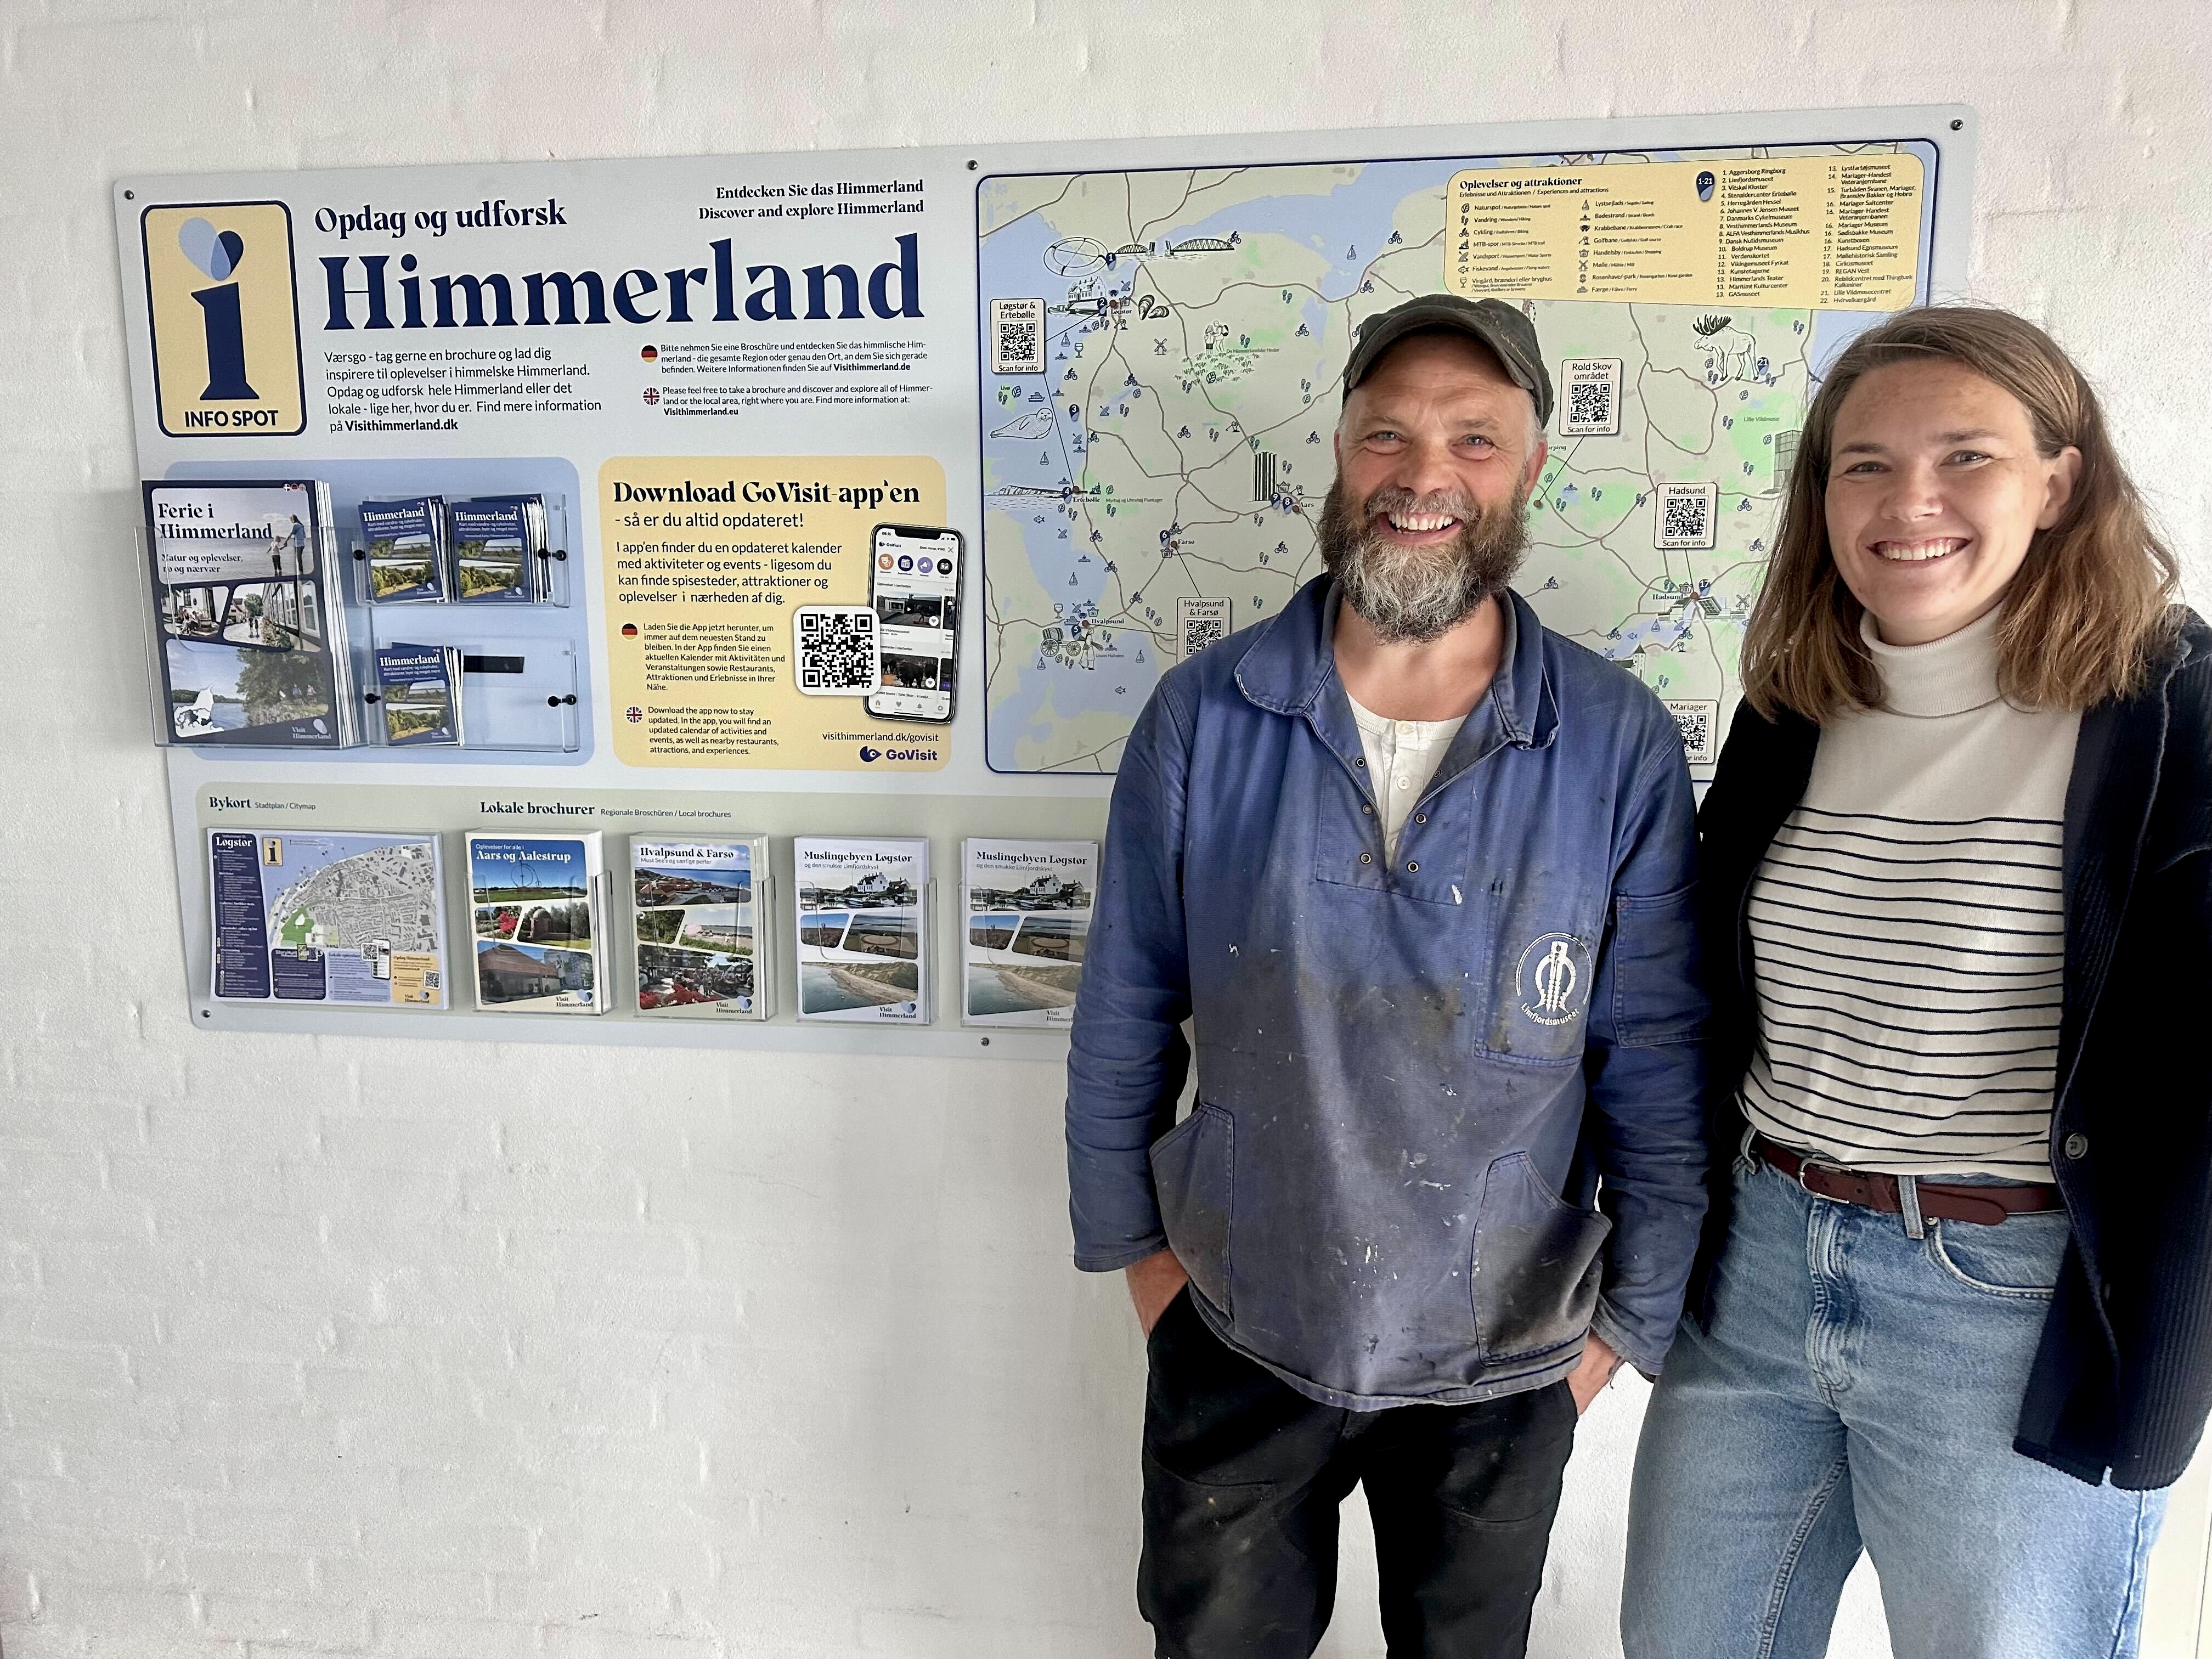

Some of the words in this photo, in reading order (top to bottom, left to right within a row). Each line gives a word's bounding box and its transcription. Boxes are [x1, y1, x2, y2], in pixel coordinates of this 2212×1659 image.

[716, 184, 785, 199] Entdecken
[788, 184, 808, 196] Sie
[811, 183, 834, 196] das
[837, 179, 924, 195] Himmerland
[1460, 179, 1509, 191] Oplevelser
[1510, 180, 1522, 190] og
[1524, 177, 1583, 187] attraktioner
[699, 207, 755, 219] Discover
[758, 204, 783, 217] and
[786, 203, 834, 219] explore
[837, 199, 924, 215] Himmerland
[315, 204, 407, 240] Opdag
[414, 211, 447, 236] og
[455, 198, 567, 228] udforsk
[319, 233, 925, 330] Himmerland
[1000, 302, 1028, 311] Løgstør
[1000, 311, 1035, 319] Ertebølle
[326, 369, 375, 382] inspirere
[376, 368, 387, 379] til
[390, 367, 447, 381] oplevelser
[449, 366, 452, 378] i
[455, 365, 515, 377] himmelske
[517, 364, 590, 376] Himmerland.
[662, 365, 695, 374] befinden.
[696, 365, 727, 373] Weitere
[729, 364, 781, 373] Informationen
[782, 364, 806, 372] finden
[820, 363, 832, 371] auf
[833, 362, 911, 371] Visithimmerland.de
[1572, 363, 1590, 371] Rold
[1592, 362, 1612, 370] Skov
[1574, 371, 1609, 382] området
[327, 386, 364, 399] Opdag
[365, 388, 380, 399] og
[381, 384, 424, 397] udforsk
[428, 384, 452, 396] hele
[454, 382, 523, 395] Himmerland
[526, 382, 551, 394] eller
[553, 382, 572, 393] det
[184, 410, 229, 427] INFO
[232, 410, 279, 427] SPOT
[663, 407, 738, 416] Visithimmerland.eu
[330, 420, 343, 434] på
[345, 419, 459, 431] Visithimmerland.dk
[613, 480, 736, 503] Download
[742, 479, 920, 510] GoVisit-app'en
[1669, 486, 1706, 494] Hadsund
[157, 503, 203, 518] Ferie
[208, 503, 214, 518] i
[363, 506, 425, 522] Himmerland
[455, 511, 518, 521] Himmerland
[624, 511, 640, 527] så
[644, 516, 659, 527] er
[663, 512, 681, 527] du
[686, 512, 719, 527] altid
[723, 512, 803, 530] opdateret!
[160, 523, 273, 539] Himmerland
[617, 541, 619, 552] I
[623, 541, 659, 555] app'en
[661, 541, 696, 553] finder
[698, 541, 712, 553] du
[715, 544, 729, 553] en
[731, 541, 789, 555] opdateret
[792, 542, 842, 554] kalender
[201, 554, 243, 563] oplevelser,
[618, 574, 639, 585] kan
[641, 574, 670, 585] finde
[672, 574, 740, 588] spisesteder,
[742, 575, 811, 586] attraktioner
[814, 578, 828, 589] og
[619, 590, 678, 604] oplevelser
[682, 591, 685, 602] i
[691, 591, 749, 603] nærheden
[752, 591, 763, 603] af
[765, 591, 785, 606] dig.
[1184, 600, 1224, 608] Hvalpsund
[379, 653, 440, 667] Himmerland
[686, 706, 698, 714] the
[1670, 703, 1707, 712] Mariager
[822, 732, 939, 743] visithimmerland.dk/govisit
[886, 749, 938, 761] GoVisit
[209, 796, 251, 811] Bykort
[255, 802, 285, 810] Stadtplan
[289, 802, 316, 811] Citymap
[480, 801, 524, 814] Lokale
[527, 802, 595, 815] brochurer
[601, 808, 634, 817] Regionale
[476, 850, 501, 860] Aars
[503, 853, 516, 863] og
[518, 850, 571, 864] Aalestrup
[640, 847, 694, 859] Hvalpsund
[697, 849, 704, 857] &
[706, 849, 733, 858] Farsø
[804, 851, 872, 863] Muslingebyen
[875, 853, 912, 864] Løgstør
[977, 851, 1047, 865] Muslingebyen
[1049, 855, 1088, 866] Løgstør
[1521, 1002, 1579, 1025] Limfjordsmuseet
